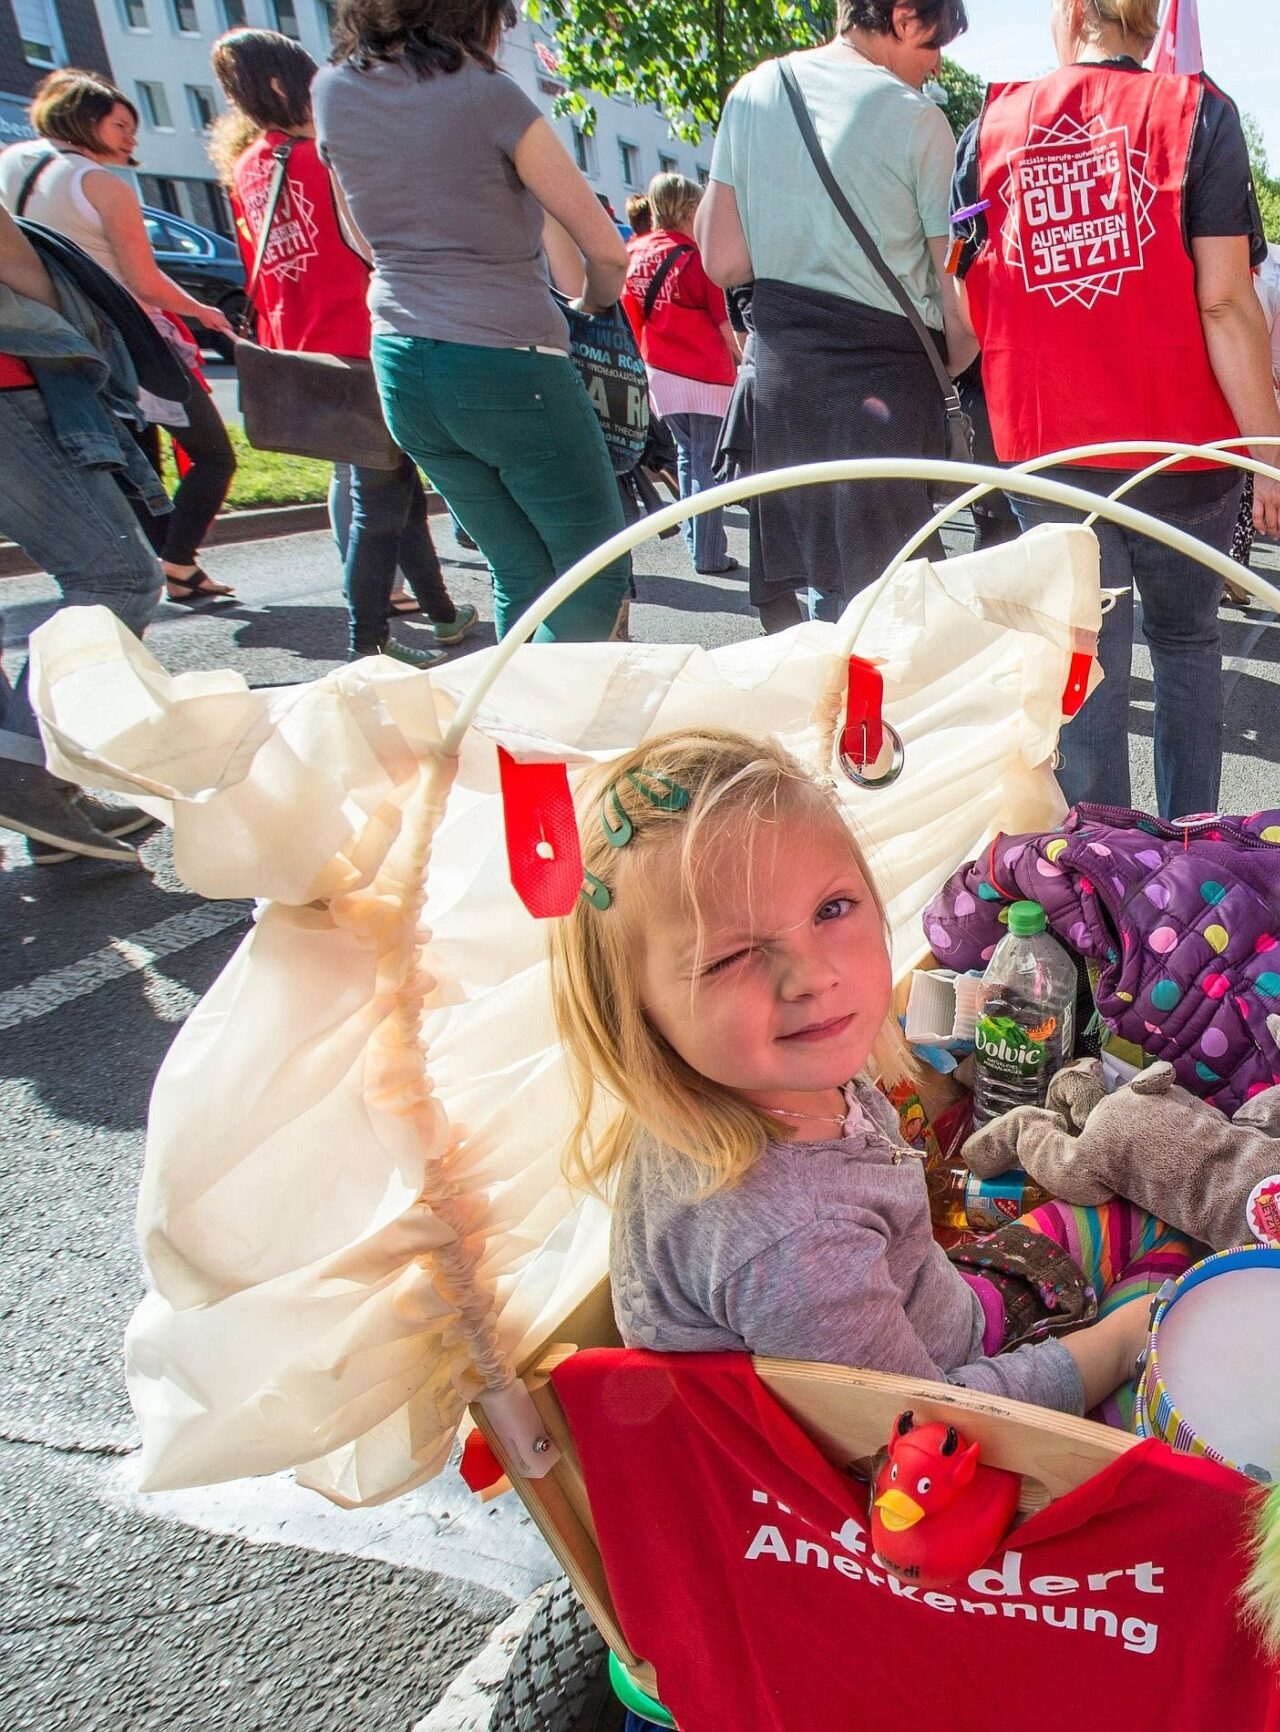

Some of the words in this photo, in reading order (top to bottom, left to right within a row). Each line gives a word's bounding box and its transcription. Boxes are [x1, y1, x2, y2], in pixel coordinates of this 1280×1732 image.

[1019, 150, 1120, 190] RICHTIG
[1022, 179, 1096, 227] GUT
[1031, 213, 1127, 250] AUFWERTEN
[1033, 230, 1131, 276] JETZT!
[975, 1025, 1041, 1065] Volvic
[744, 1525, 1159, 1654] Anerkennung
